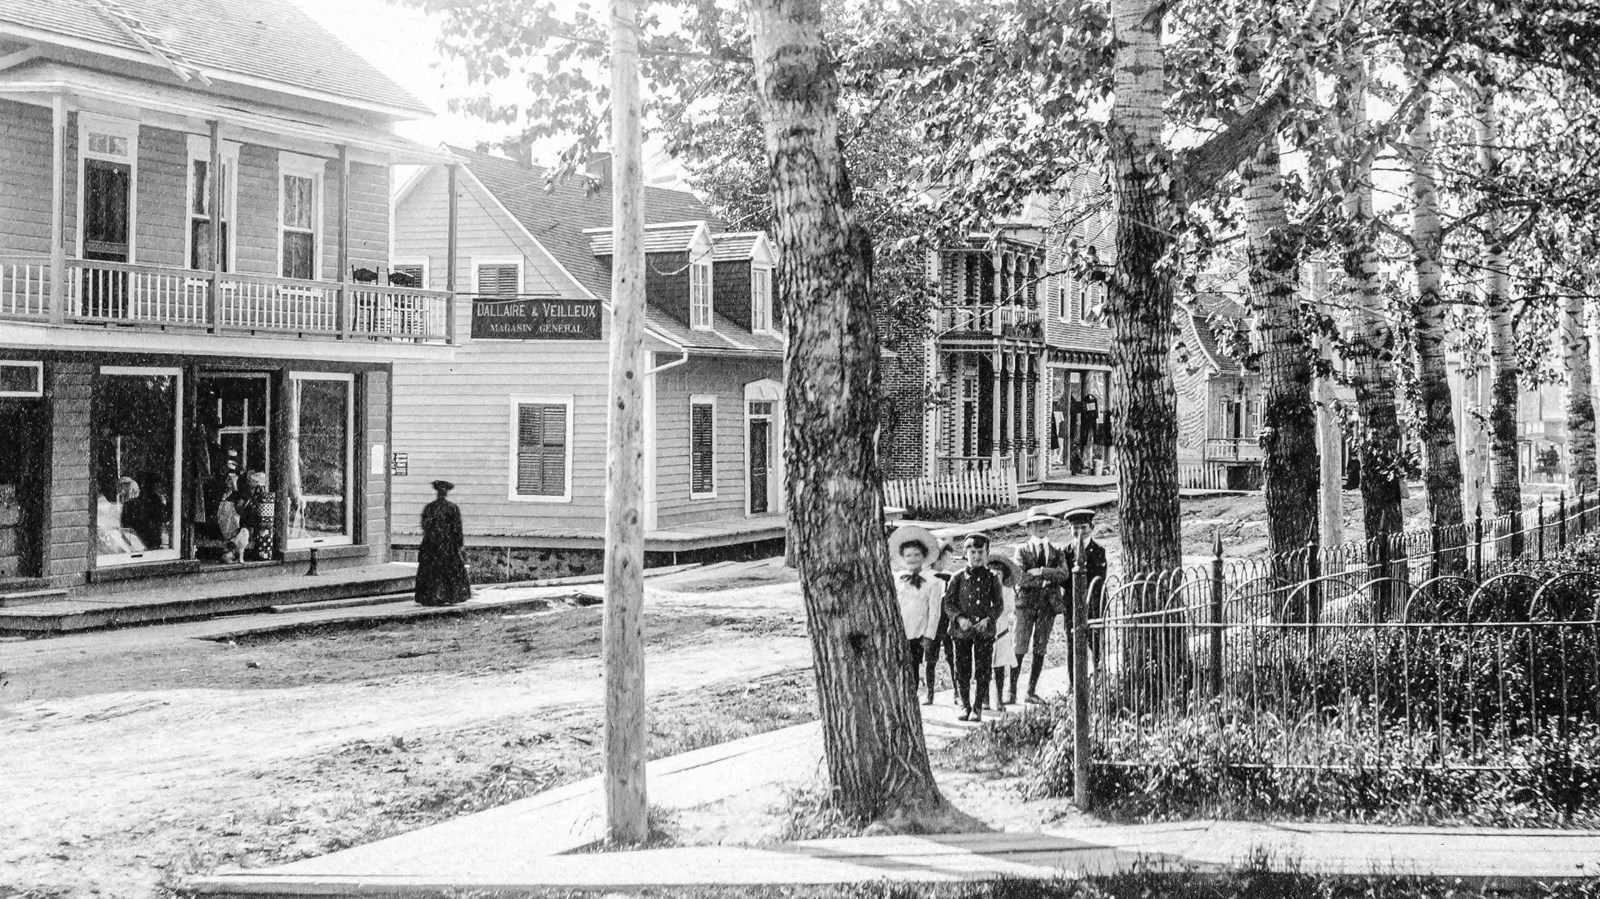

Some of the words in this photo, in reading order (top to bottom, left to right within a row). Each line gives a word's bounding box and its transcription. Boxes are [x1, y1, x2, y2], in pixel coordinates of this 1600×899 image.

[477, 302, 526, 316] DALLAIRE
[531, 306, 539, 316] &
[542, 303, 596, 317] VEILLEUX
[490, 324, 532, 333] MAGASIN
